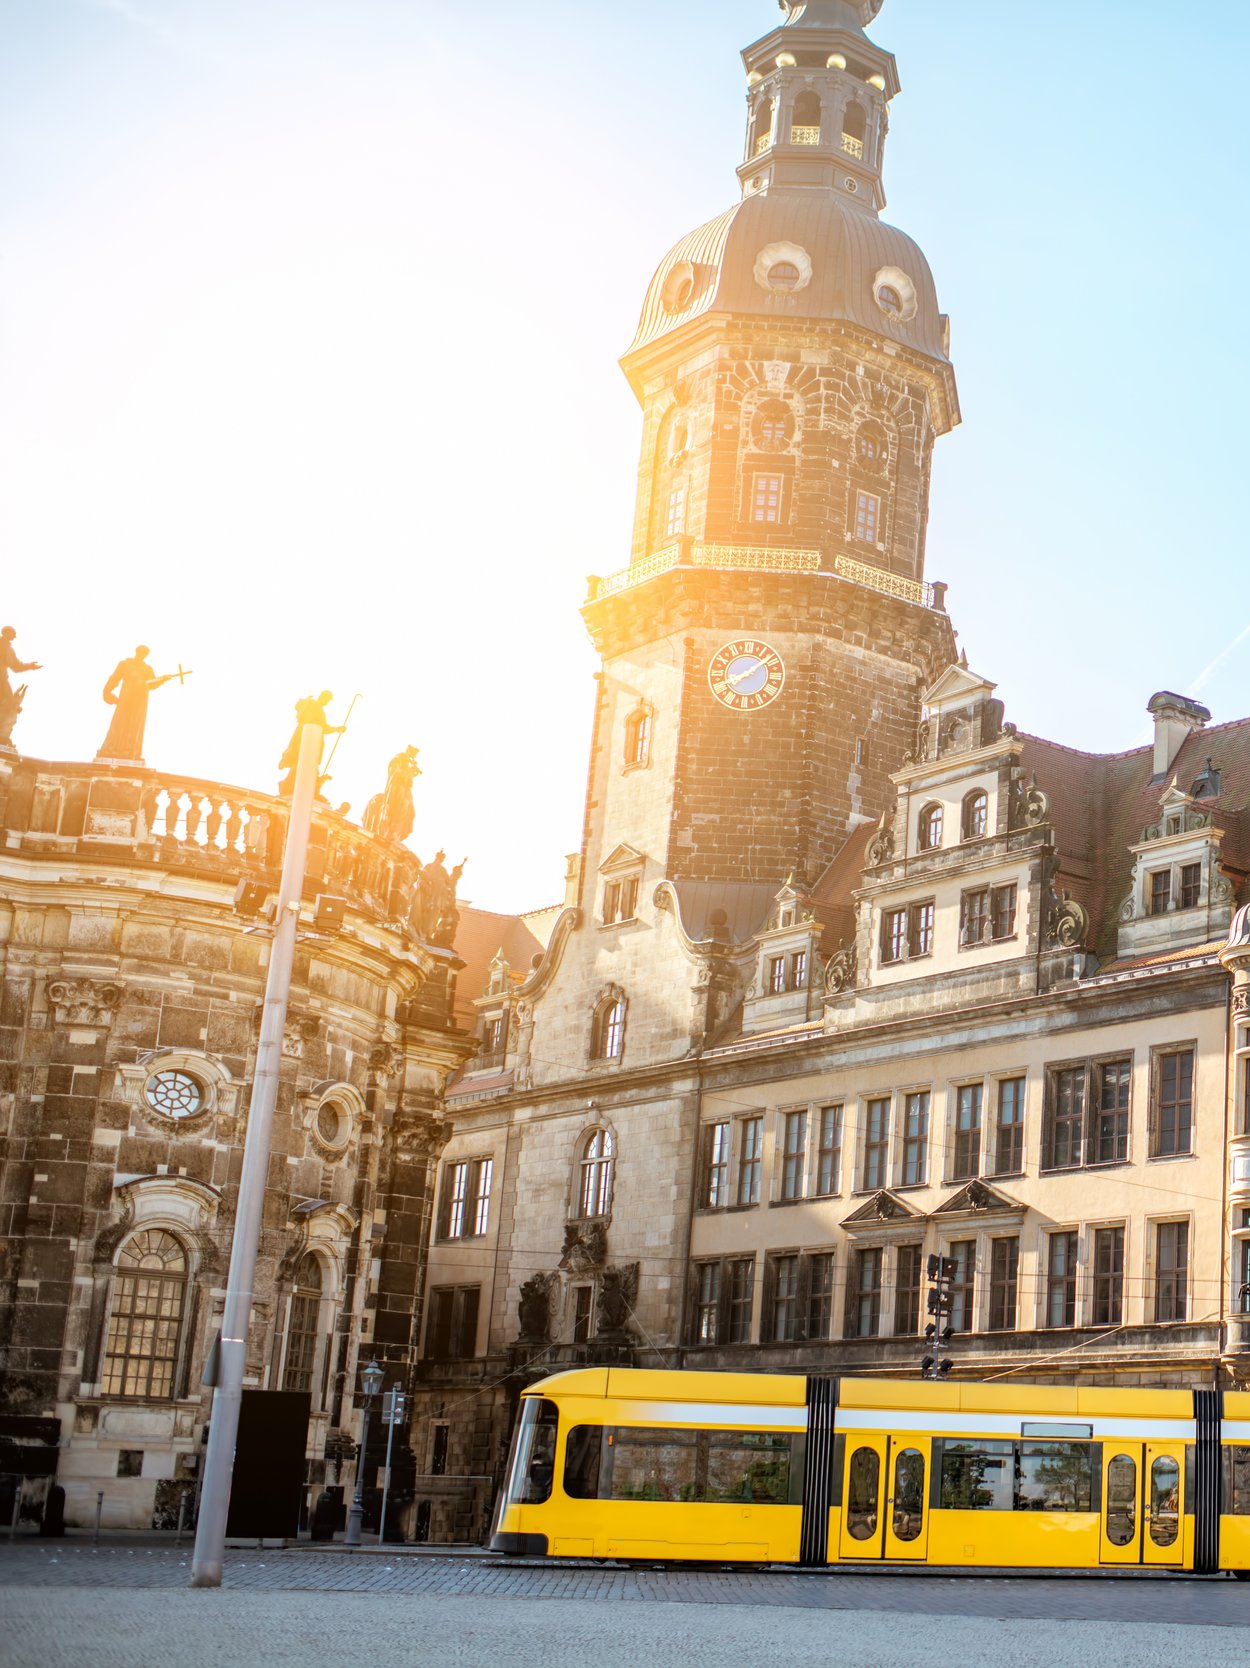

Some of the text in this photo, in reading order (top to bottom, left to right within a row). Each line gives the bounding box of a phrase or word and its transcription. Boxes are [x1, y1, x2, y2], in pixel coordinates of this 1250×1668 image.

[728, 644, 739, 657] XI
[744, 641, 754, 653] XII
[716, 654, 729, 665] X
